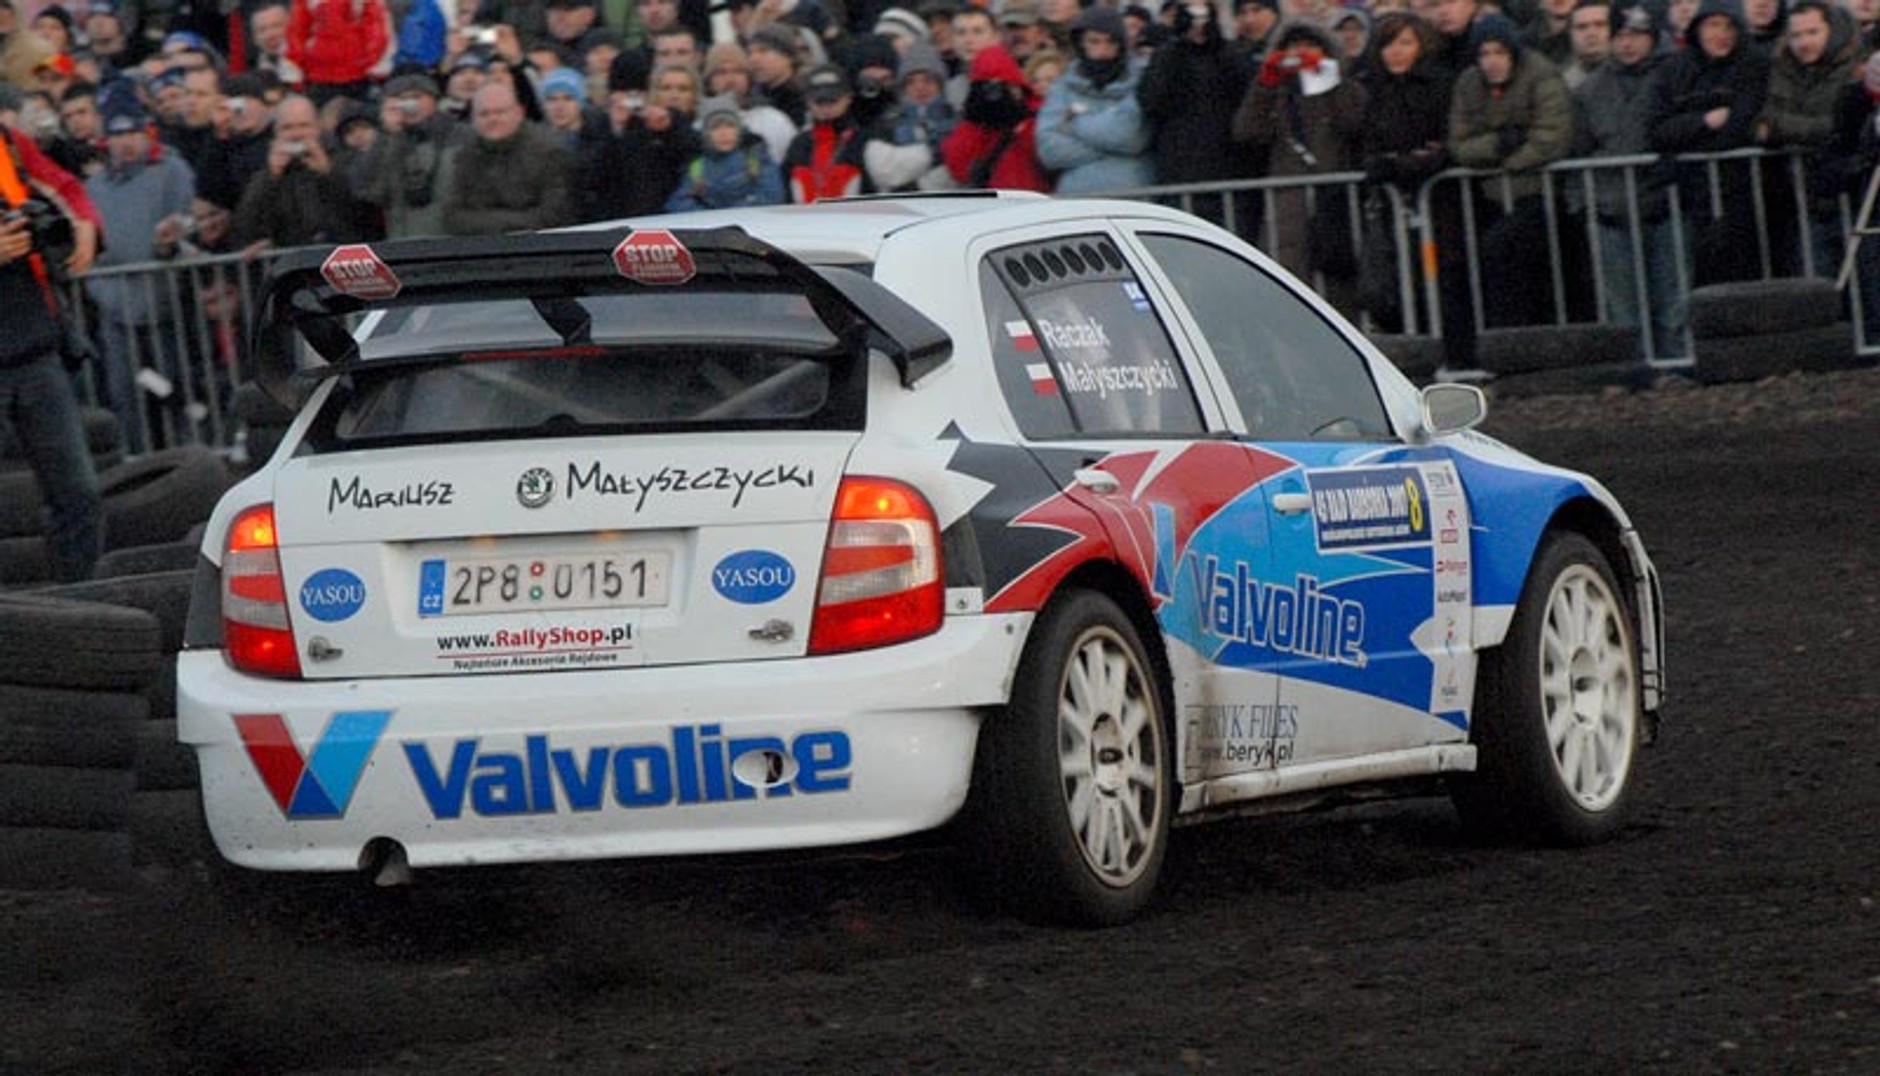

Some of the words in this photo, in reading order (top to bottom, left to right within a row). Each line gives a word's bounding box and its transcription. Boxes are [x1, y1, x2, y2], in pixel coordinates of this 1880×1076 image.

[328, 258, 376, 279] STOP
[624, 243, 678, 263] STOP
[1038, 317, 1111, 349] Raczak
[1056, 358, 1179, 399] Małyszczycki
[1405, 476, 1424, 532] 8
[452, 564, 520, 605] 2P8
[715, 566, 792, 589] YASOU
[302, 584, 364, 606] YASOU
[422, 596, 440, 608] CZ
[1187, 551, 1370, 668] Valvoline
[436, 624, 632, 650] www.RallyShop.pl
[1249, 705, 1298, 739] FILES
[402, 723, 854, 821] Valvoline
